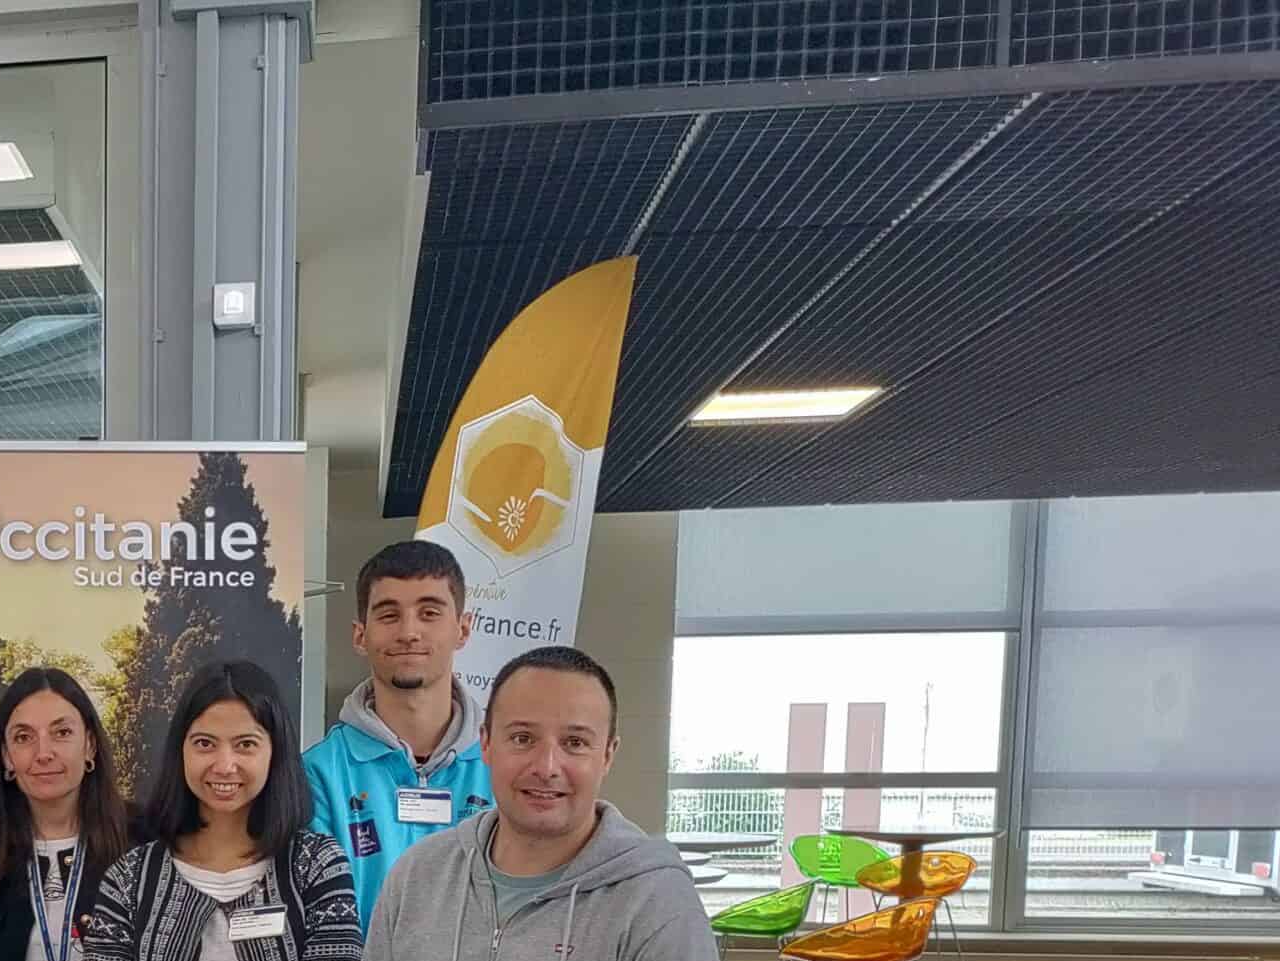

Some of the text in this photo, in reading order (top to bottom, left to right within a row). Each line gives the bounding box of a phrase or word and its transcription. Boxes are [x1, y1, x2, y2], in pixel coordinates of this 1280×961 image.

[73, 566, 256, 587] Sud de France
